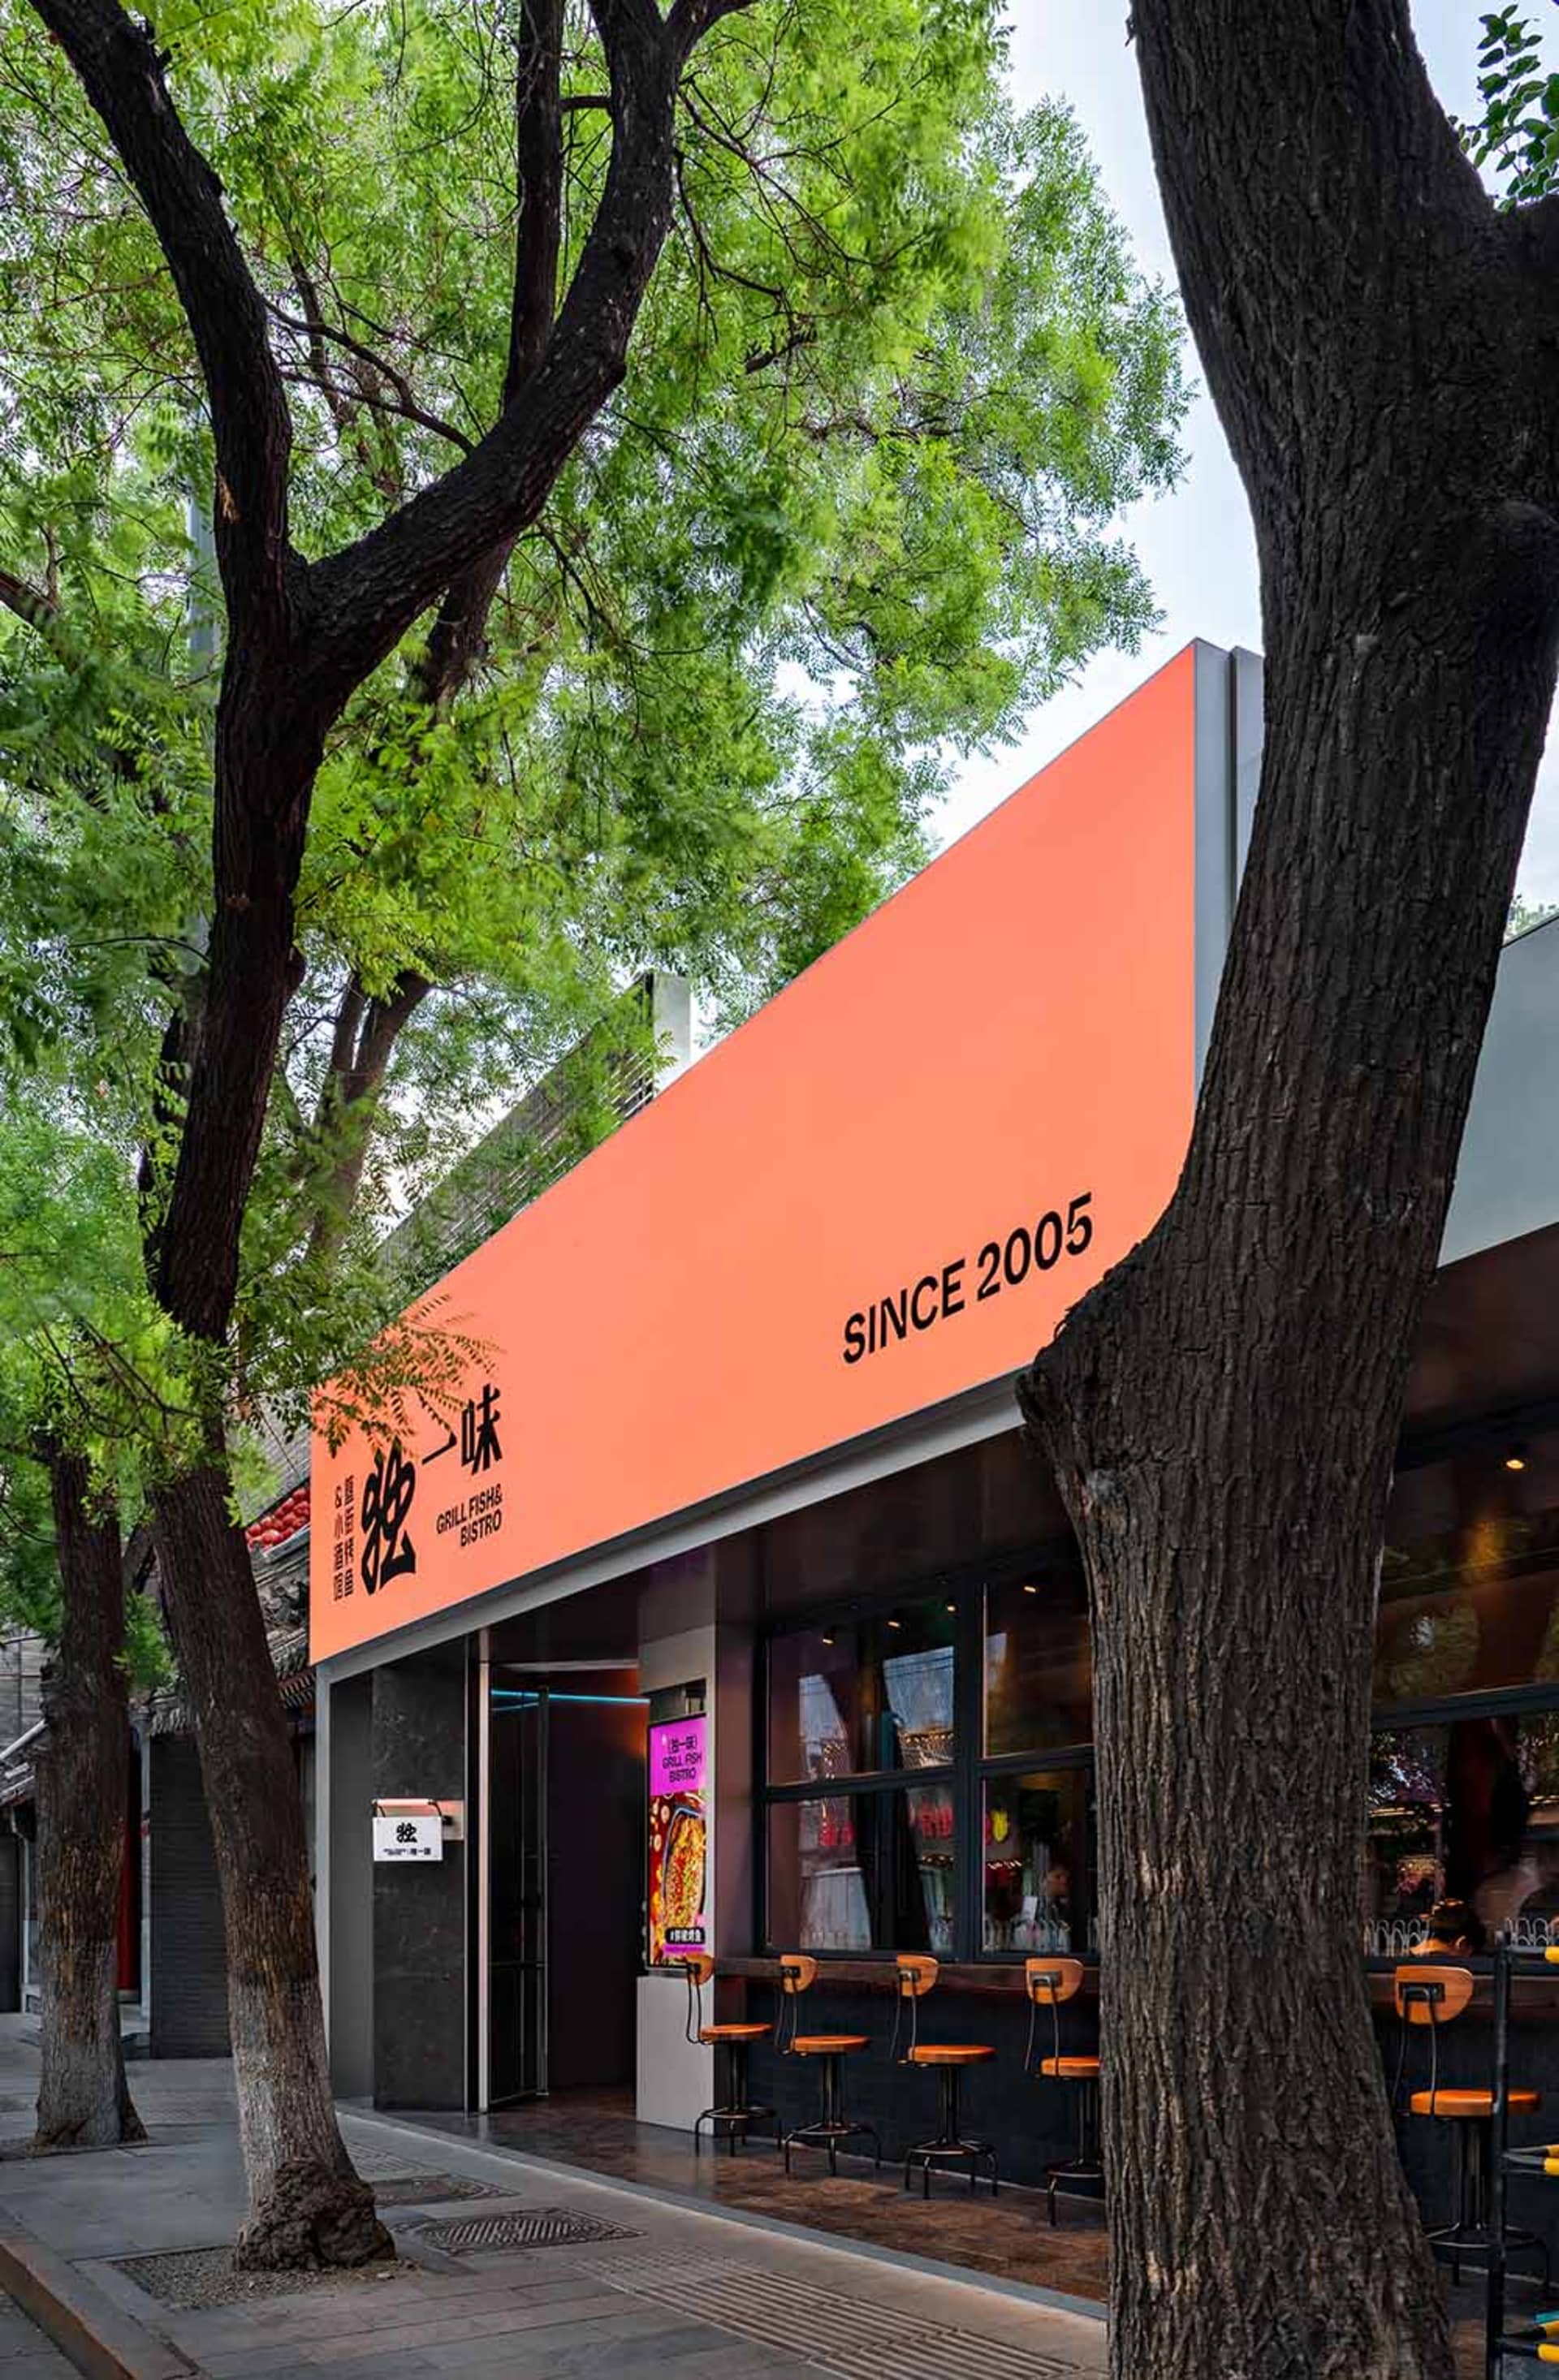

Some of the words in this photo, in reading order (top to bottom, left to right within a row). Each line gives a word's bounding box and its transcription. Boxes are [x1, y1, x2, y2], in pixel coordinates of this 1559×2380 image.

[843, 1258, 966, 1364] SINCE
[977, 1192, 1093, 1301] 2005
[436, 1502, 468, 1534] GRILL
[460, 1508, 502, 1546] BISTRO
